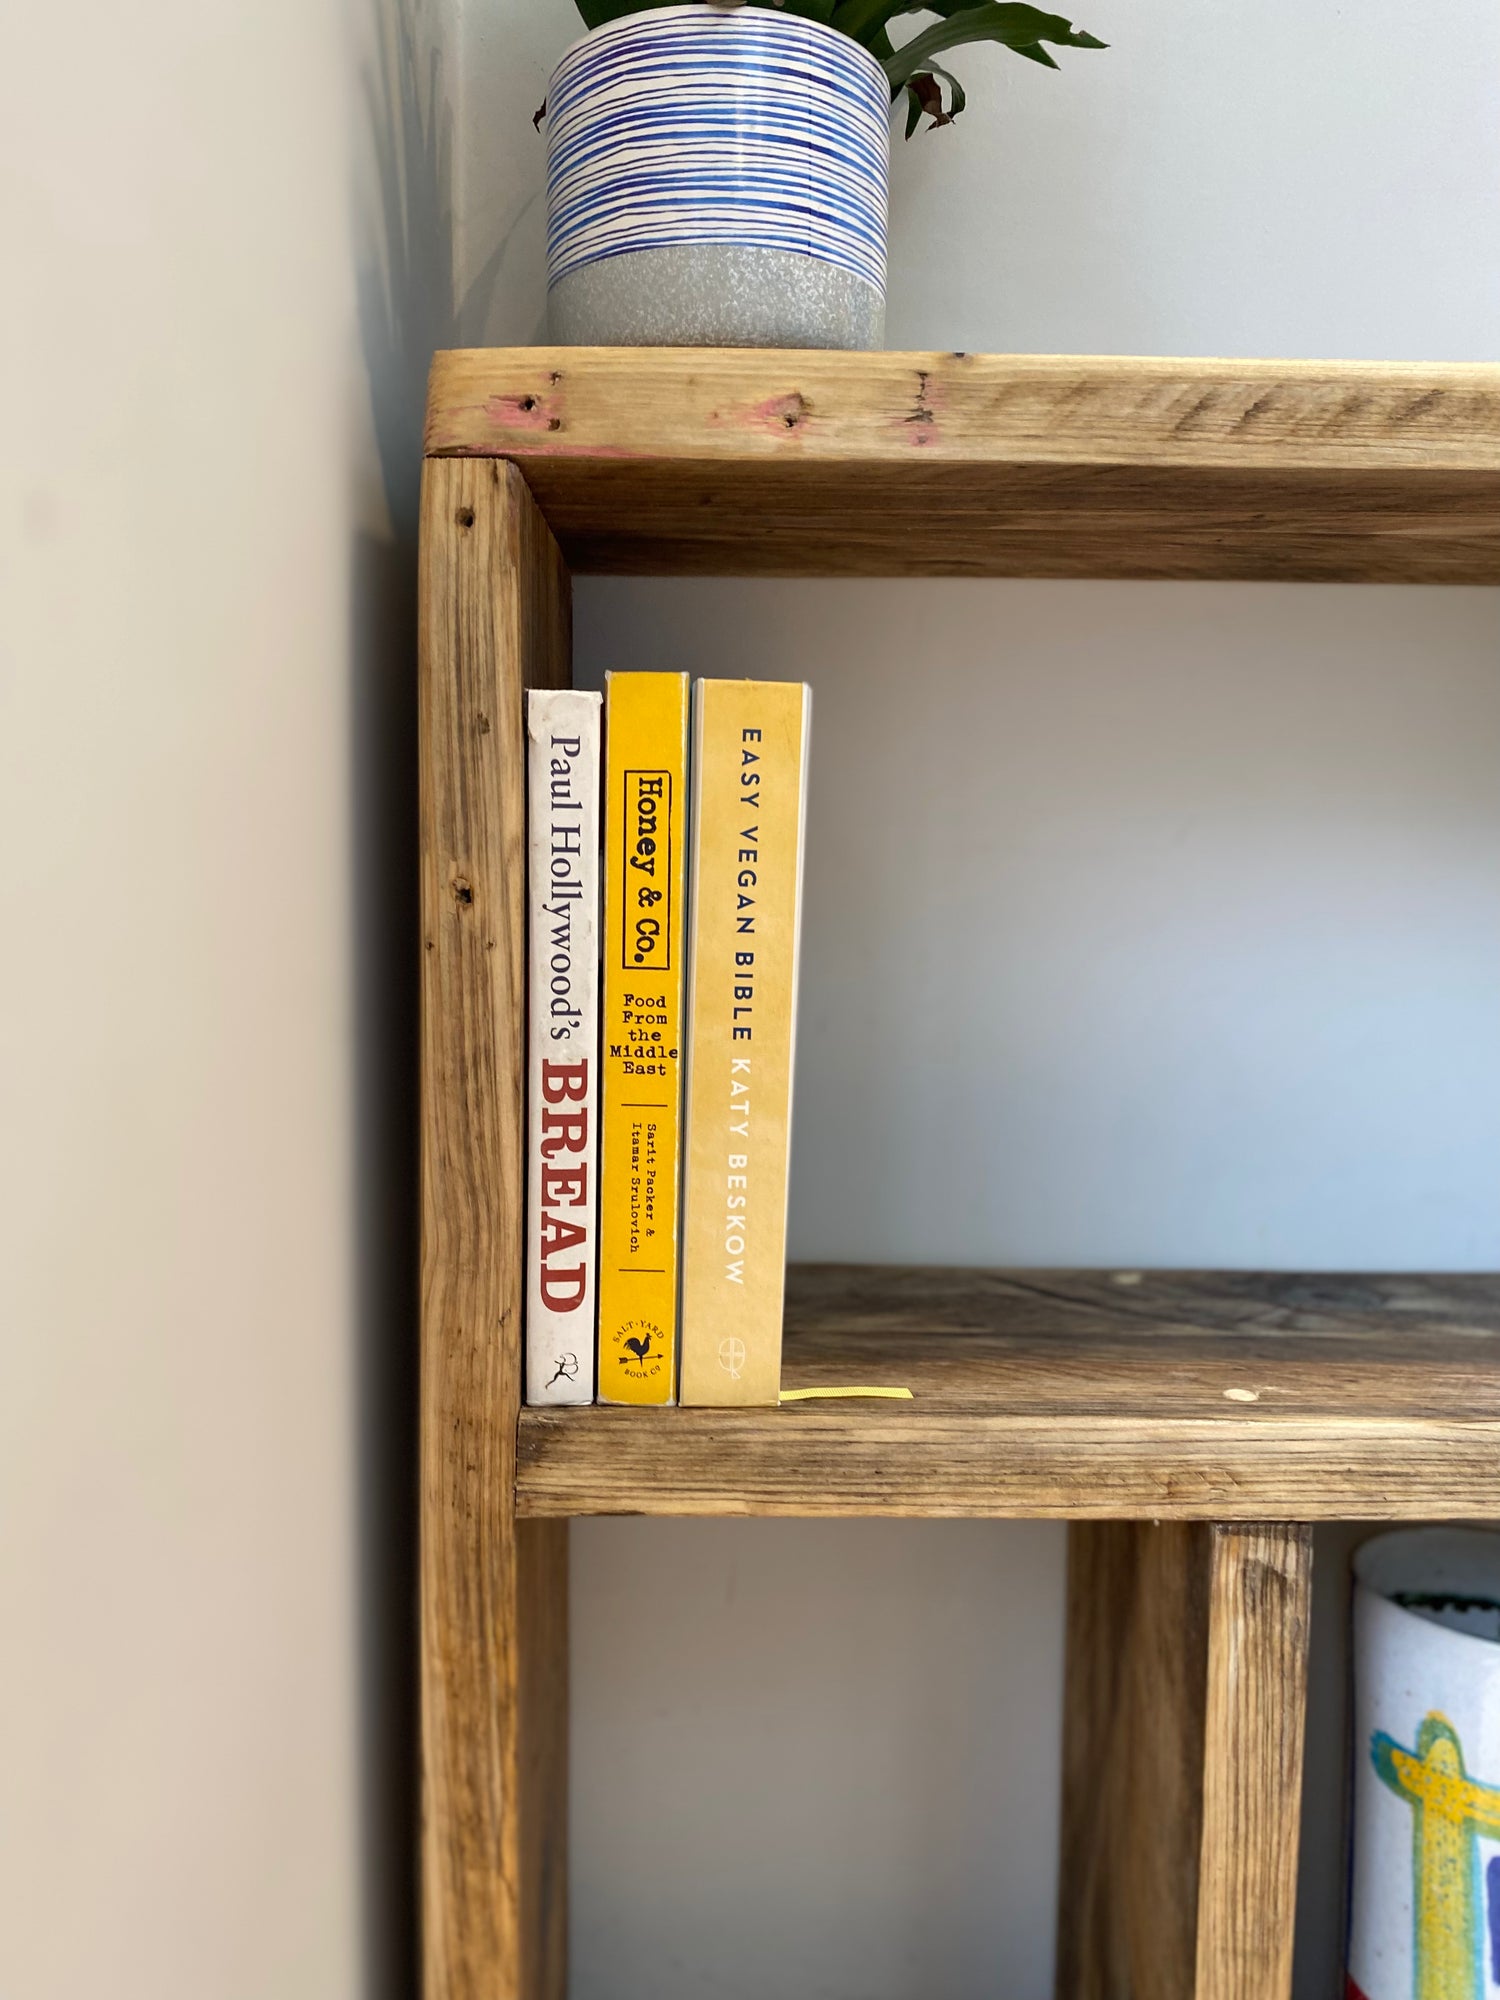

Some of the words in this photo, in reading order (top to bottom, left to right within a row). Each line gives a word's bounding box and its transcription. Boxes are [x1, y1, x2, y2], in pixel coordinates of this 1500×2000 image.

[550, 735, 583, 811] Paul
[740, 728, 762, 808] EASY
[630, 777, 663, 876] Honey
[638, 887, 663, 908] &
[736, 826, 759, 934] VEGAN
[542, 823, 584, 1041] Hollywood's
[634, 918, 661, 964] Co.
[622, 1010, 668, 1025] From
[623, 993, 667, 1009] Food
[732, 952, 755, 1041] BIBLE
[610, 1045, 679, 1060] Middle
[628, 1028, 662, 1042] the
[623, 1061, 667, 1077] East
[729, 1058, 752, 1138] KATY
[631, 1122, 643, 1173] Itamar
[645, 1123, 657, 1165] Sarit
[540, 1058, 589, 1313] BREAD
[645, 1170, 657, 1221] Packer
[630, 1177, 641, 1254] Srulovich
[645, 1228, 656, 1238] &
[724, 1153, 748, 1286] BESKOW
[624, 1368, 649, 1379] BOOK
